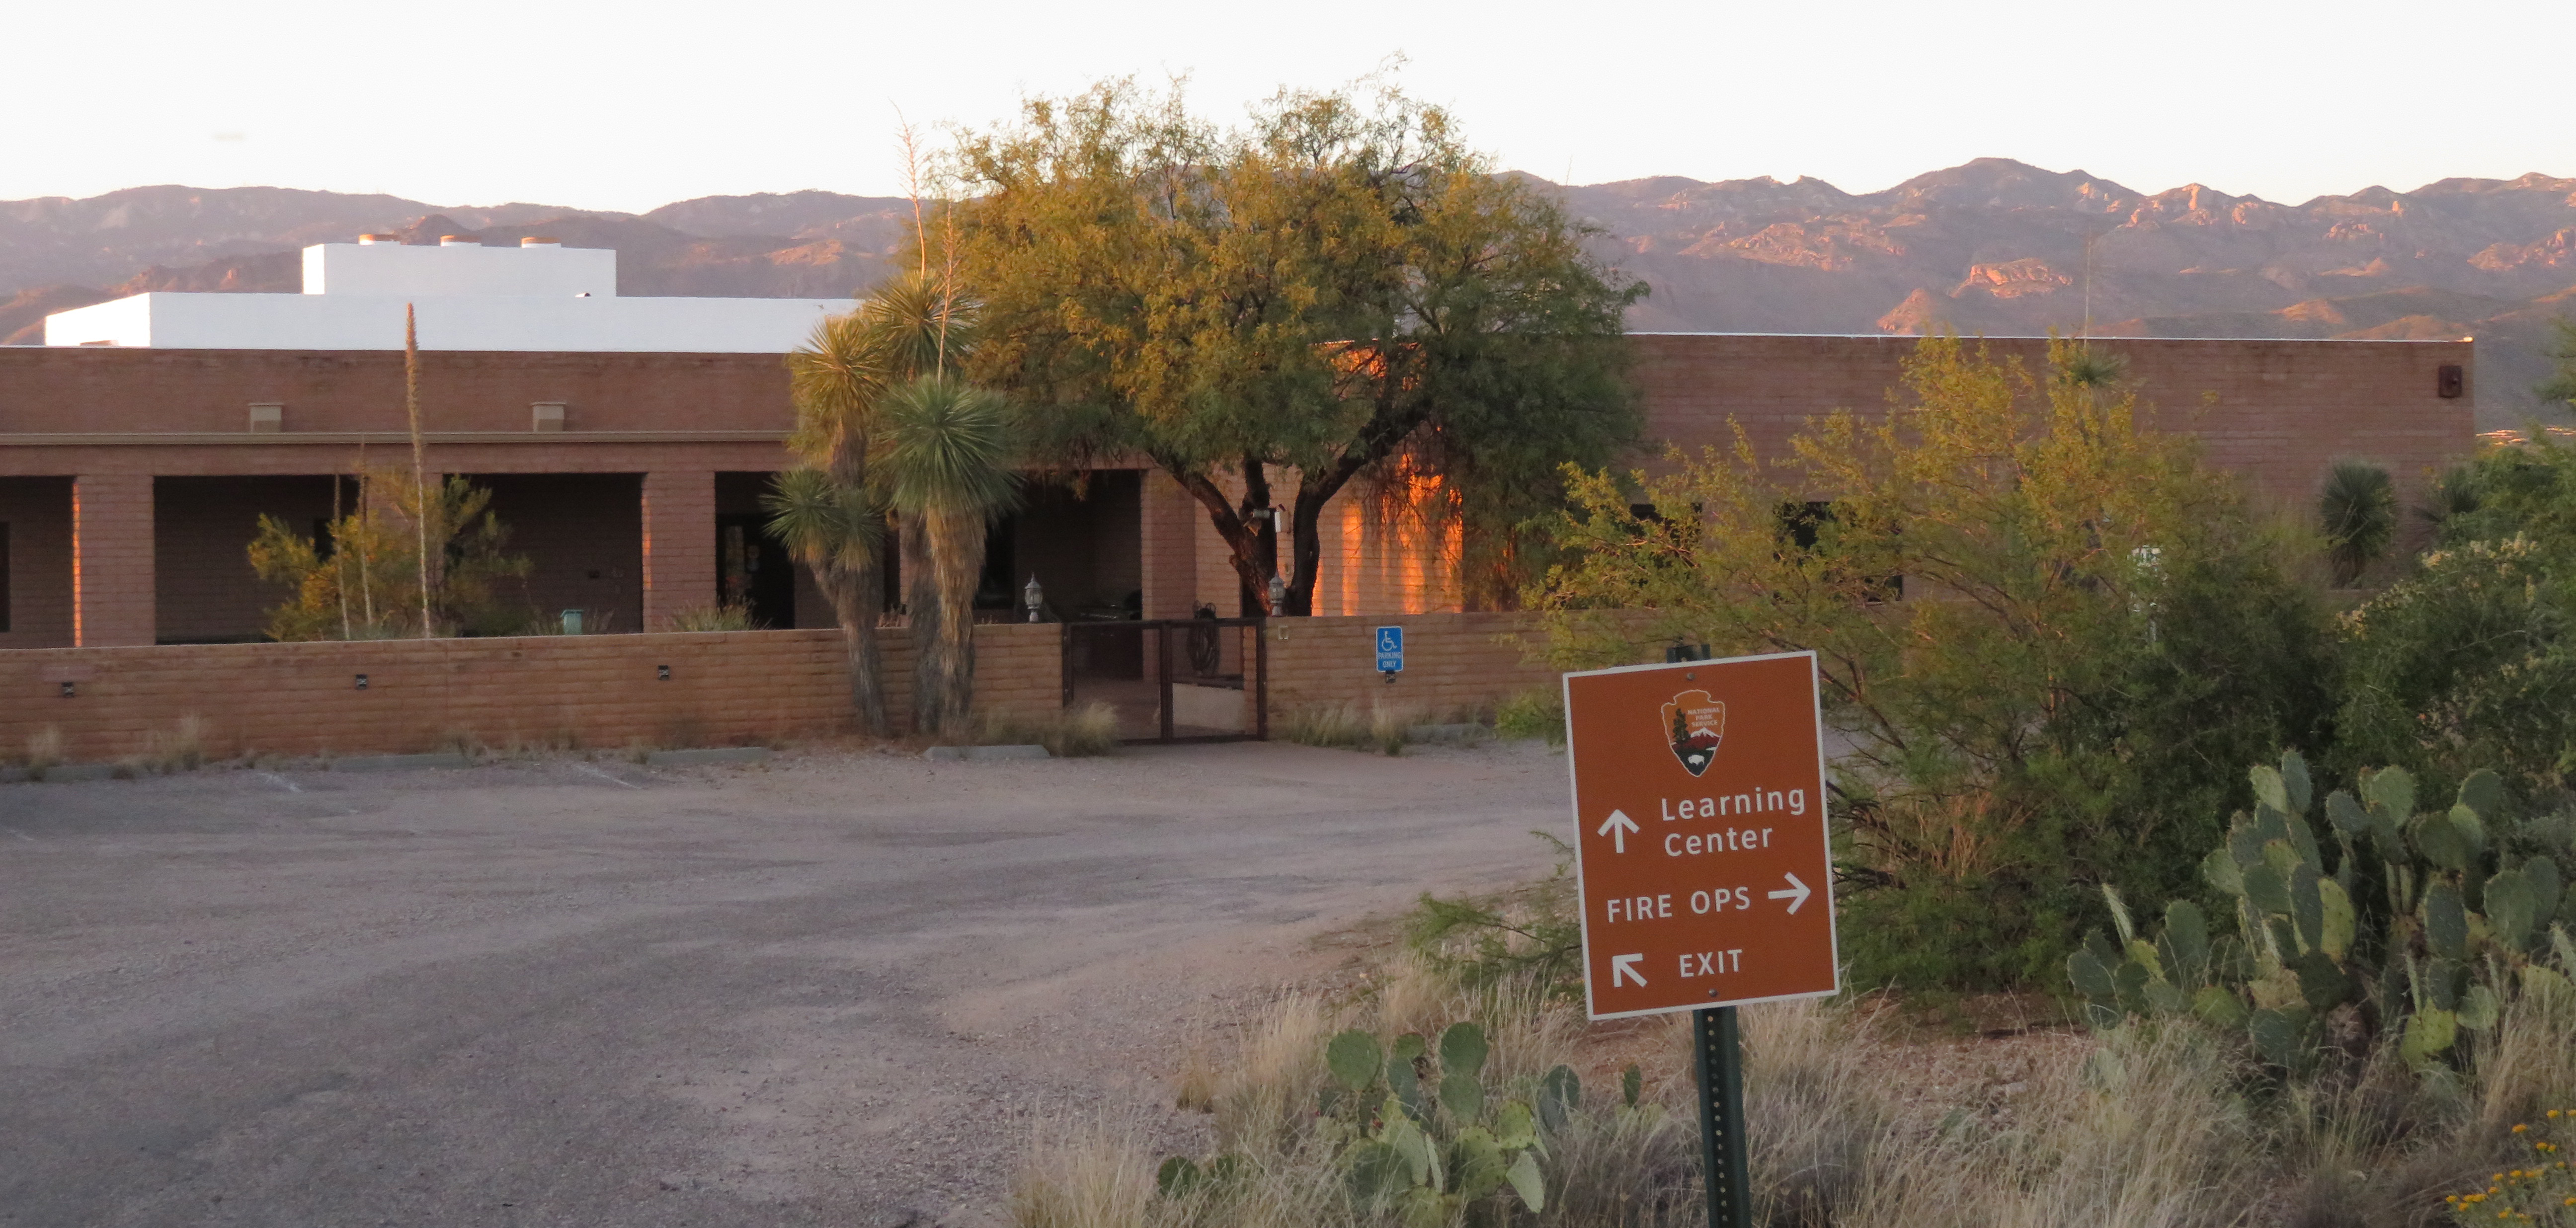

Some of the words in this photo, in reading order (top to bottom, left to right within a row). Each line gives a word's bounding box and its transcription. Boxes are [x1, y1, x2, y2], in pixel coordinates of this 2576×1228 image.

[1661, 786, 1805, 821] Learning
[1665, 827, 1772, 857] Center
[1607, 894, 1673, 923] FIRE
[1690, 886, 1750, 914] OPS
[1680, 949, 1743, 978] EXIT
